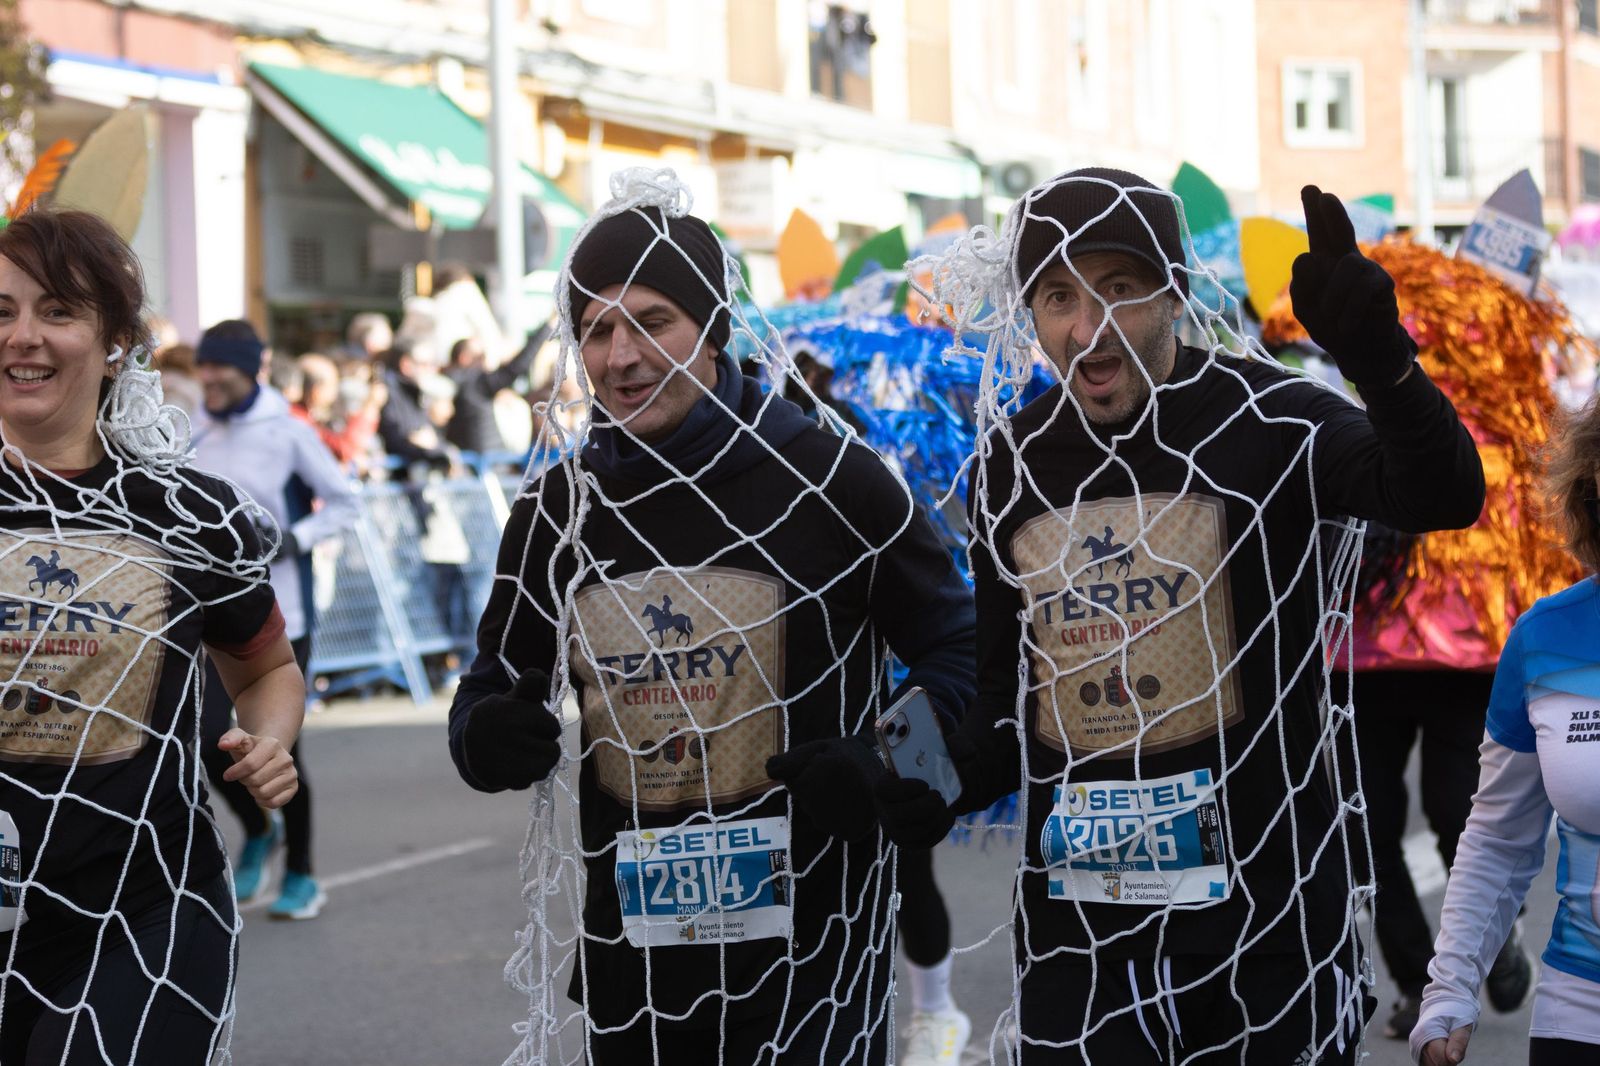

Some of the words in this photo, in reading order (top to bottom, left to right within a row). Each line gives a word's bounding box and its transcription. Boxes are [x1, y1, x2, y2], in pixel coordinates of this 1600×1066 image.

[1036, 572, 1189, 624] TERRY
[48, 664, 66, 673] 1865
[596, 645, 748, 685] TERRY
[623, 684, 717, 705] CENTENARIO
[676, 711, 692, 719] 186
[1081, 715, 1119, 723] FERNANDO
[1570, 711, 1589, 720] XLI
[1592, 710, 1600, 720] S
[1568, 722, 1600, 732] SILVE
[23, 731, 70, 741] ESPIRITUOSA
[692, 768, 713, 776] TERY
[1090, 783, 1197, 810] SETEL
[1209, 809, 1218, 826] 3026
[659, 827, 771, 855] SETEL
[1067, 815, 1178, 863] 3026
[1108, 862, 1138, 872] TONI
[645, 856, 744, 905] 2814
[709, 931, 745, 940] Salmanca
